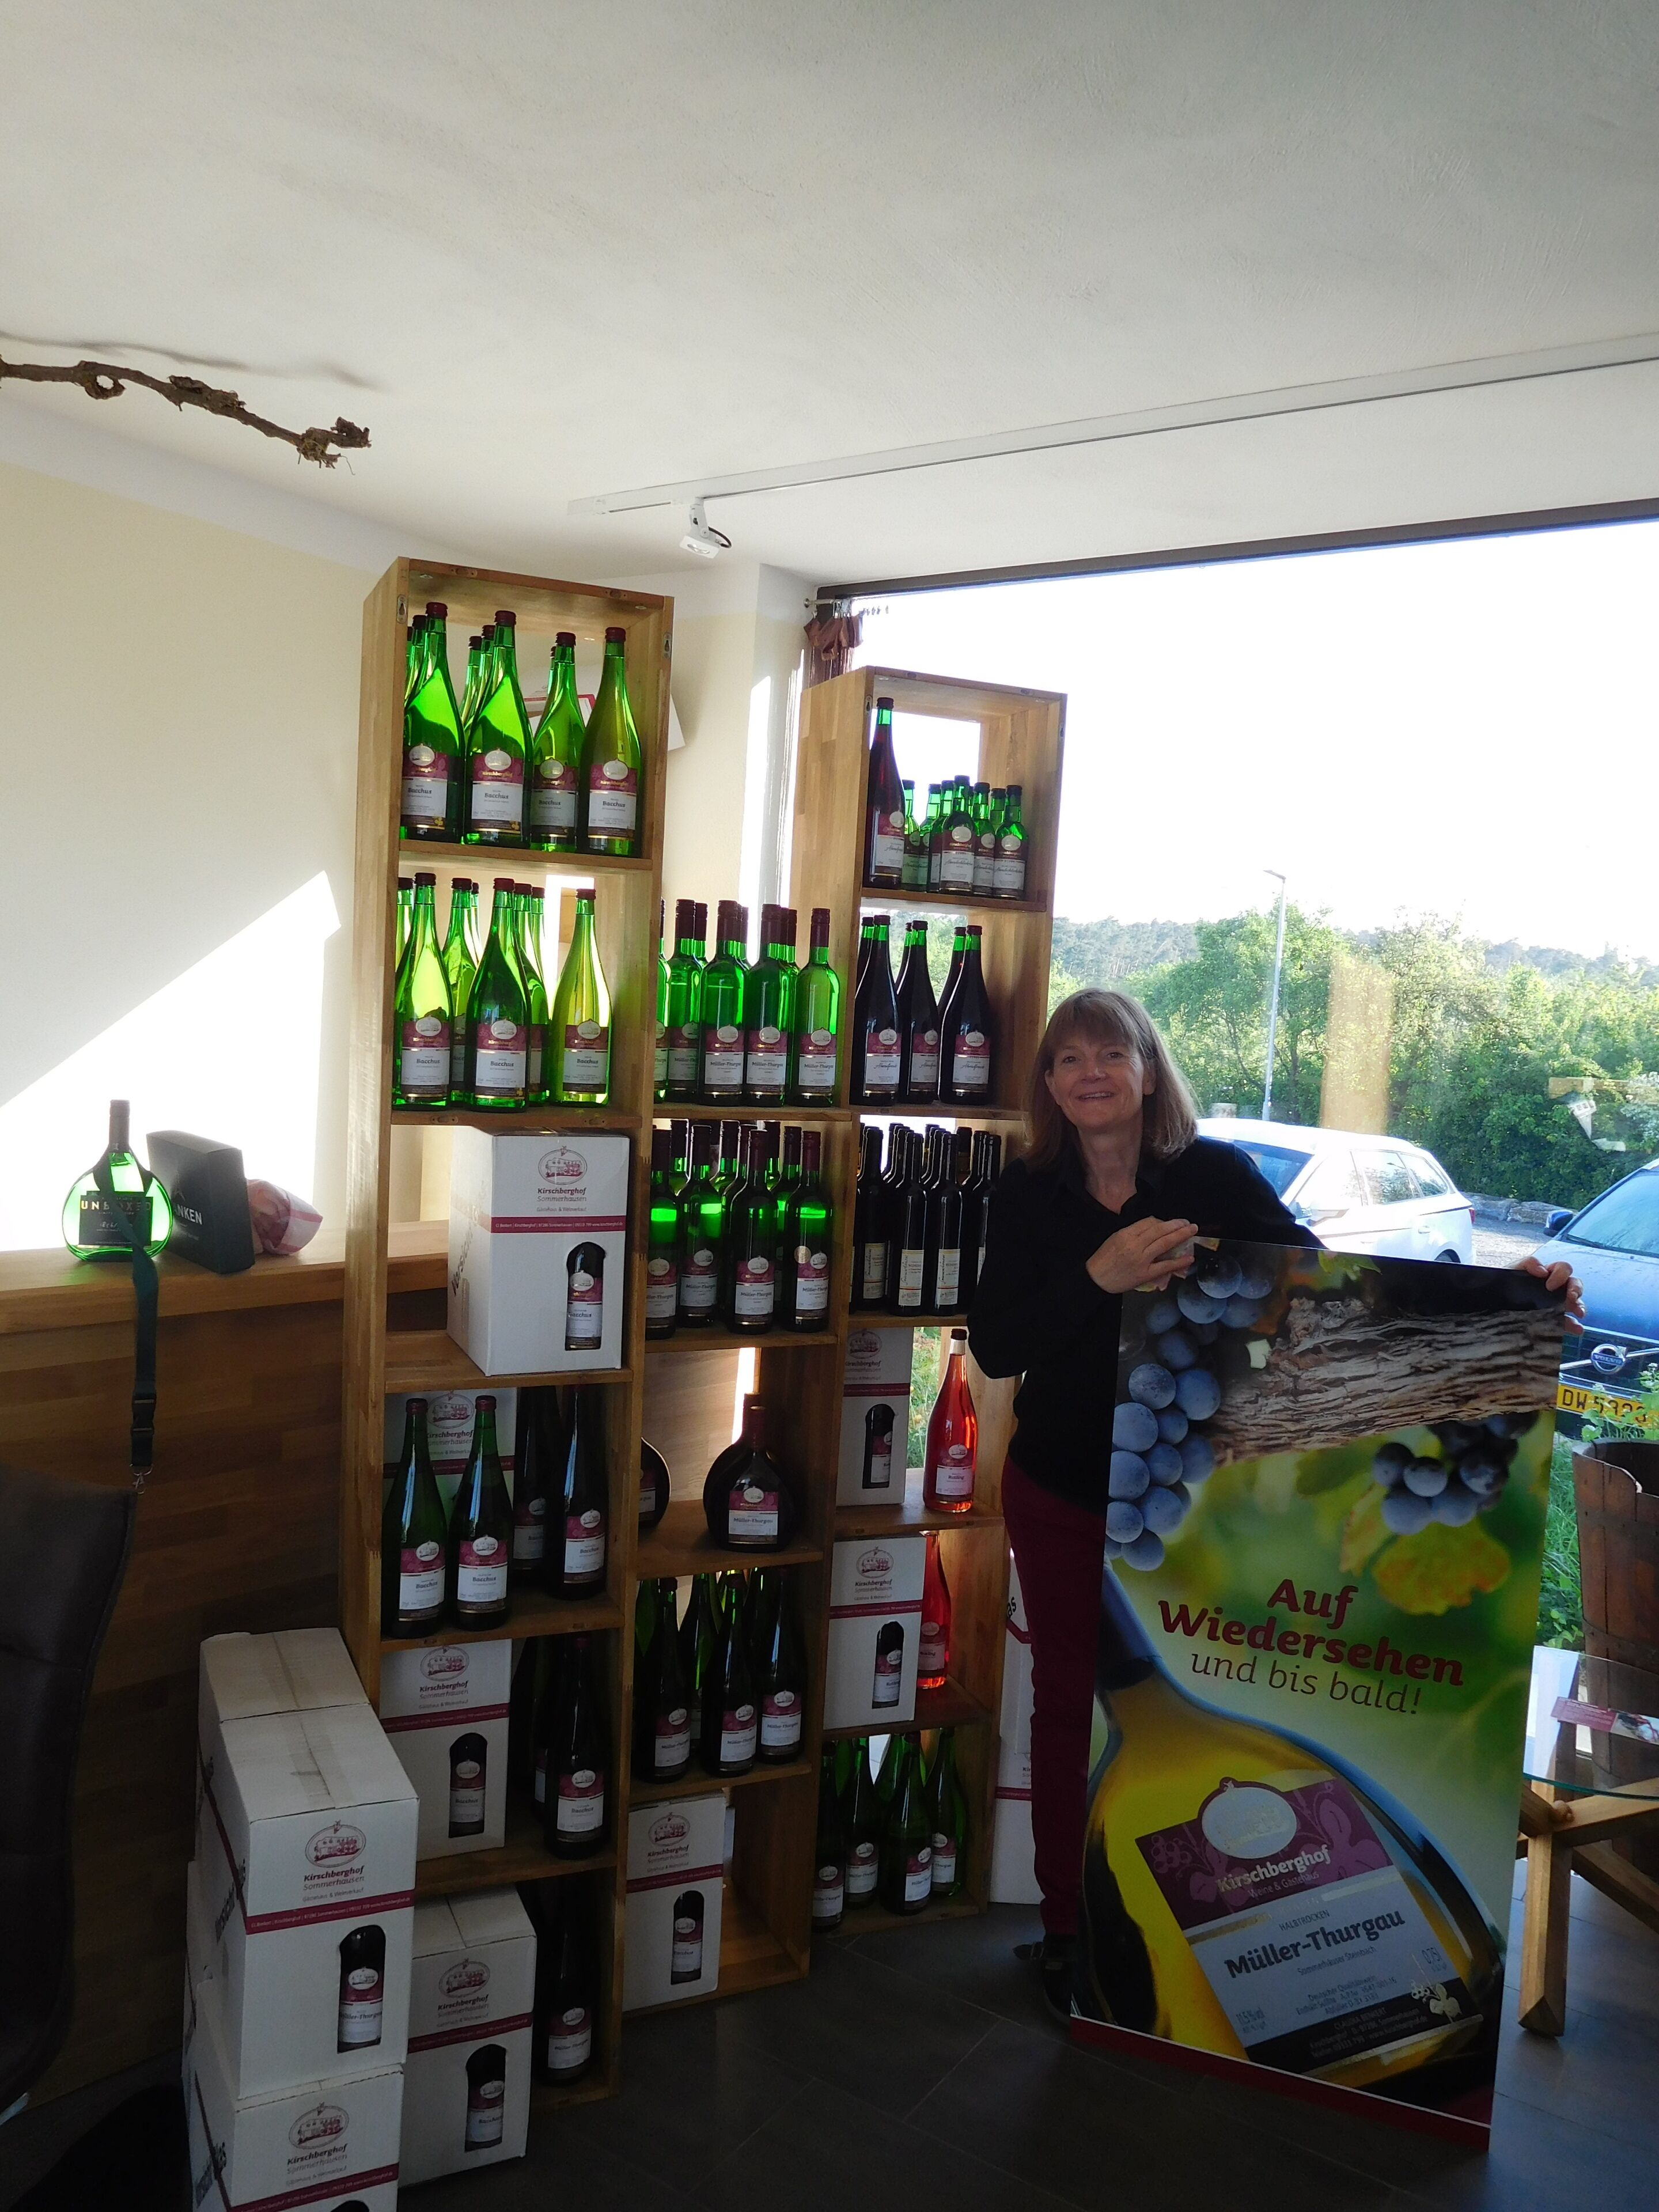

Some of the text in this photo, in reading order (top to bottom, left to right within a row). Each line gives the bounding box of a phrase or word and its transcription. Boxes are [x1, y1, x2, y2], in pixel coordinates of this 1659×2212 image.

[537, 1187, 587, 1195] Kirschberghof
[1593, 1355, 1622, 1365] VOLVO
[1562, 1389, 1587, 1410] DW
[415, 1581, 438, 1589] Bacchus
[1267, 1579, 1358, 1630] Auf
[1158, 1600, 1464, 1687] Wiedersehen
[419, 1681, 469, 1692] Kirschberghof
[1191, 1652, 1422, 1714] und bis bald!
[304, 1866, 364, 1882] Kirschberghof
[1217, 1844, 1331, 1893] Kirschberghof
[303, 1876, 364, 1890] Sommerhausen
[1248, 1881, 1273, 1900] Weine
[1274, 1880, 1281, 1892] &
[1279, 1909, 1330, 1931] HALBTROCKEN
[1224, 1910, 1405, 1978] Müller-Thurgau
[1344, 1945, 1377, 1960] Steinbach
[438, 1994, 488, 2010] Kirschberghof
[287, 2143, 348, 2165] Kirschberghof
